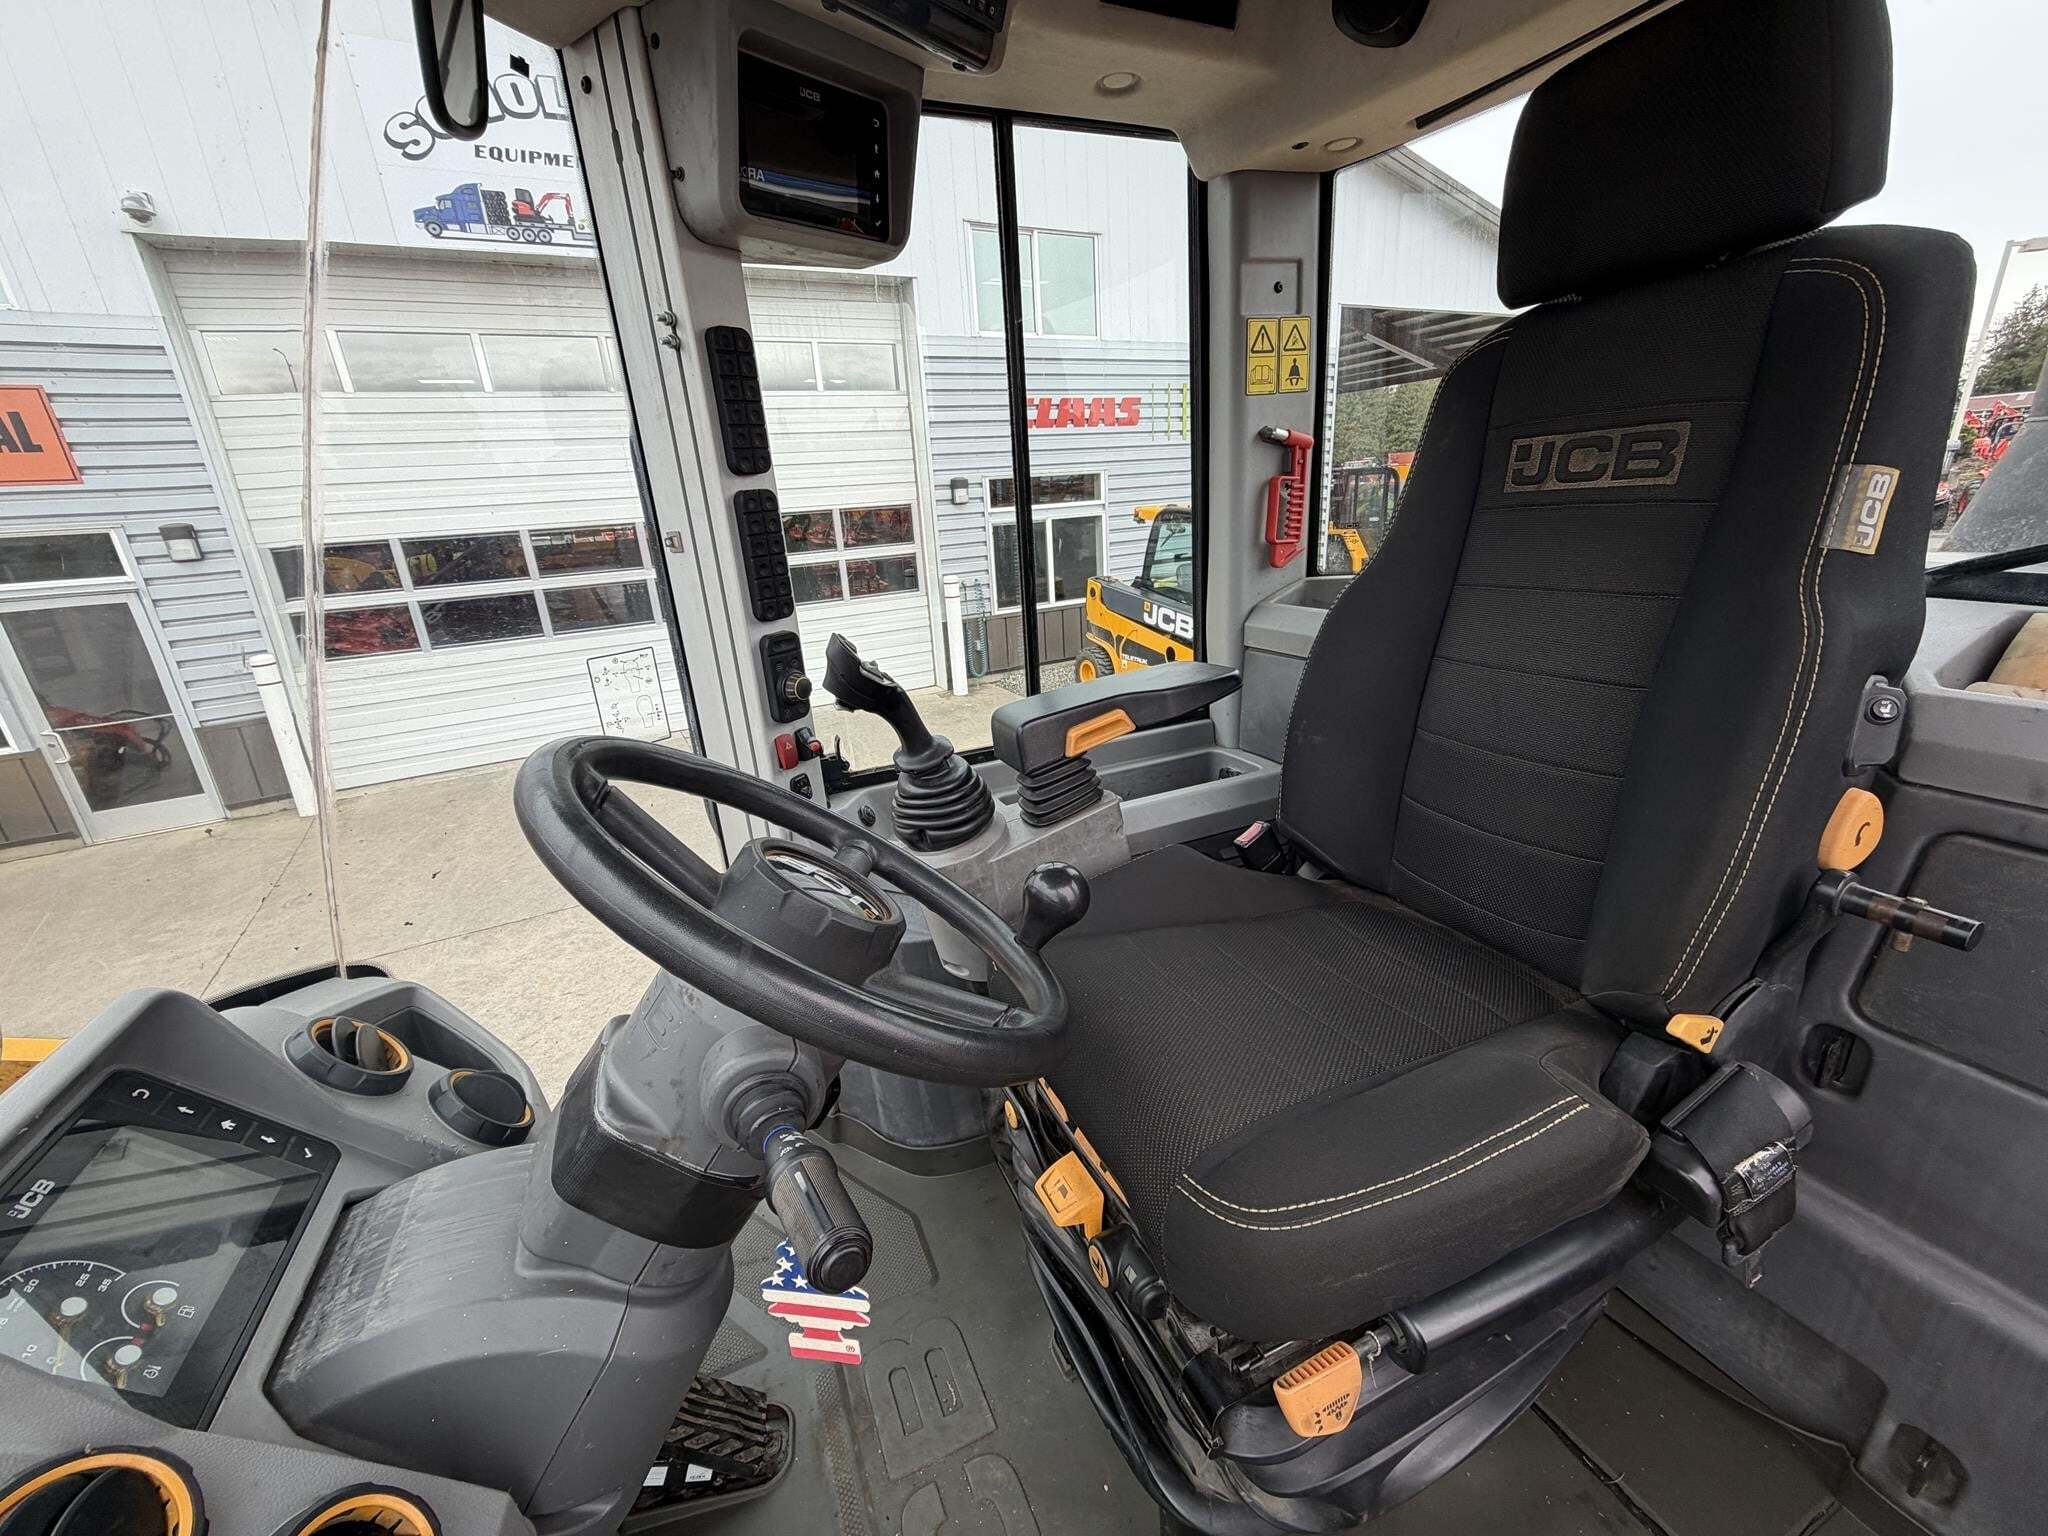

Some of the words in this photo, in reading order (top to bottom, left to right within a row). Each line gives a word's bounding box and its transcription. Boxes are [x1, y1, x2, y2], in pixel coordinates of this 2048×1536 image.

[800, 86, 821, 101] JCB
[474, 144, 579, 168] EQUIPME
[1509, 428, 1683, 487] JCB
[1854, 473, 1892, 547] JCB
[1143, 601, 1194, 639] JCB
[6, 1179, 56, 1219] JCB
[24, 1278, 39, 1293] 20
[75, 1273, 90, 1287] 25
